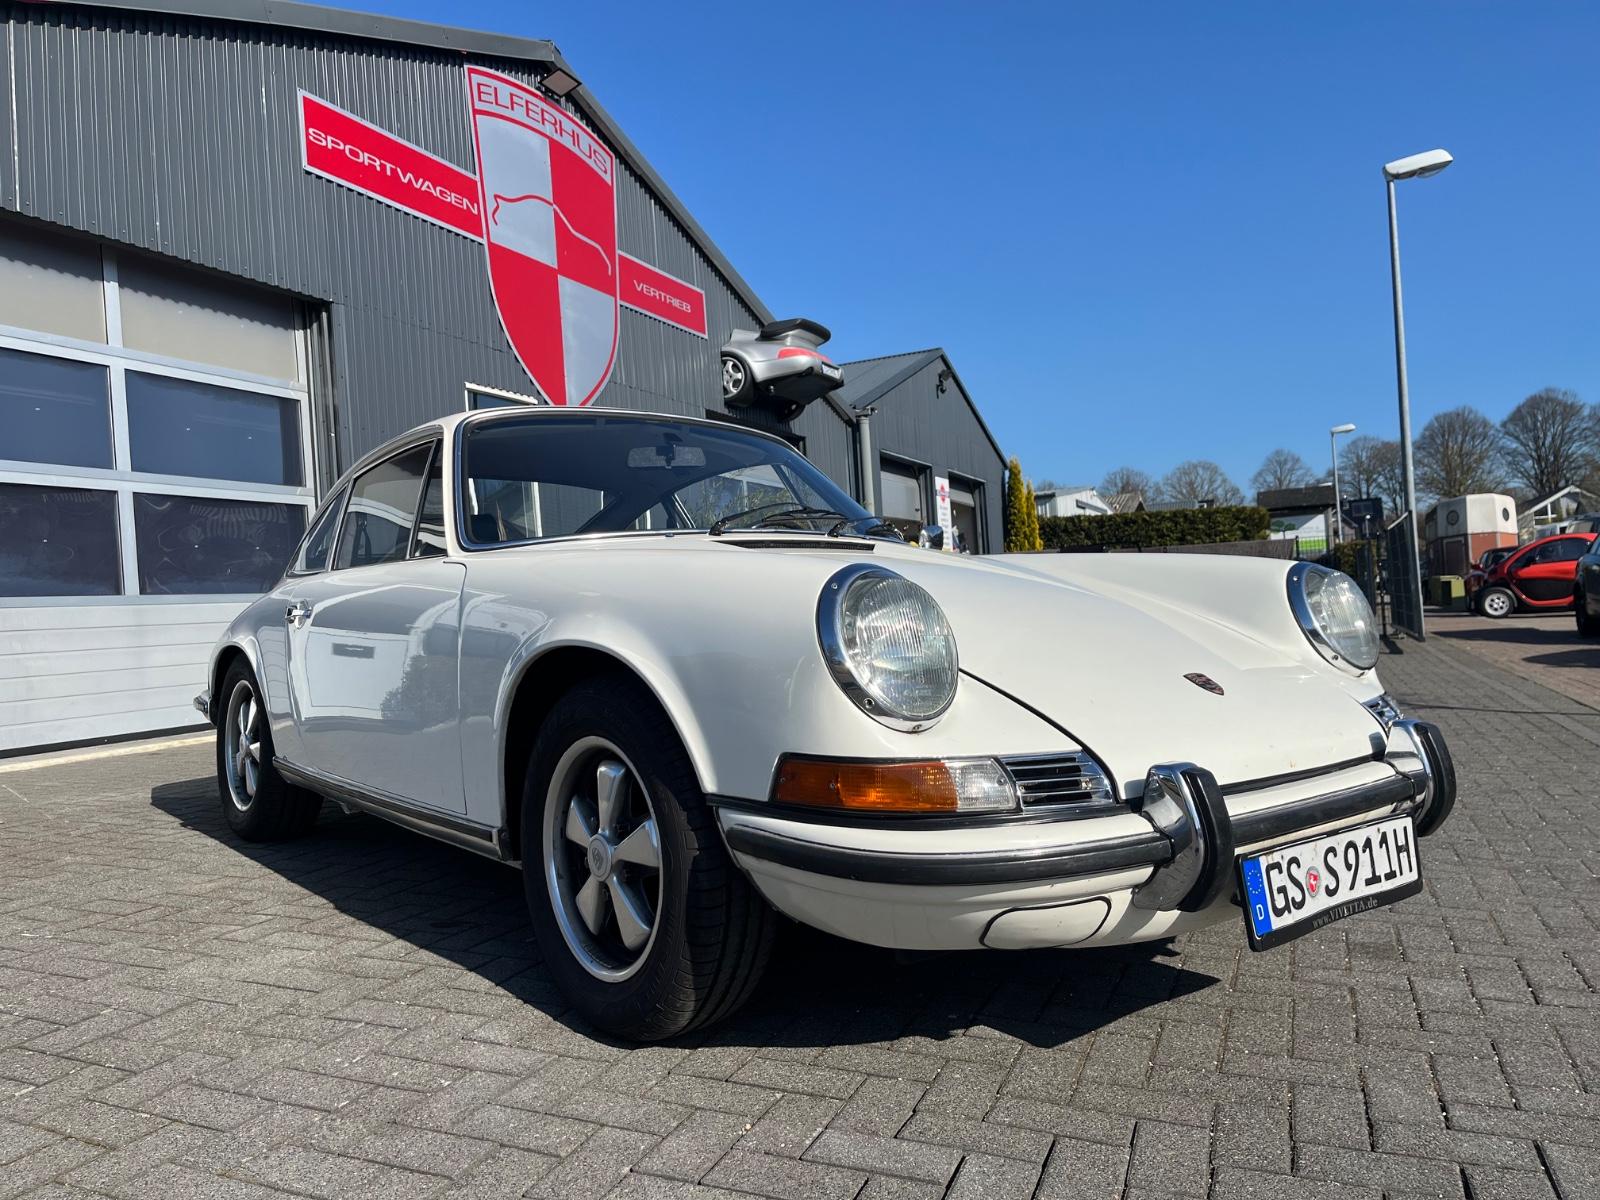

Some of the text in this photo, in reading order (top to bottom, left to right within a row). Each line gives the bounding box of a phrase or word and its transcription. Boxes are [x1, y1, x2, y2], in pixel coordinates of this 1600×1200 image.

[476, 82, 611, 175] ELFERHUS
[307, 126, 479, 216] SPORTWAGEN
[633, 279, 692, 314] VERTRIEB
[1265, 856, 1306, 918] GS
[1256, 904, 1265, 920] D
[1312, 896, 1378, 929] www.VIVETTA.de
